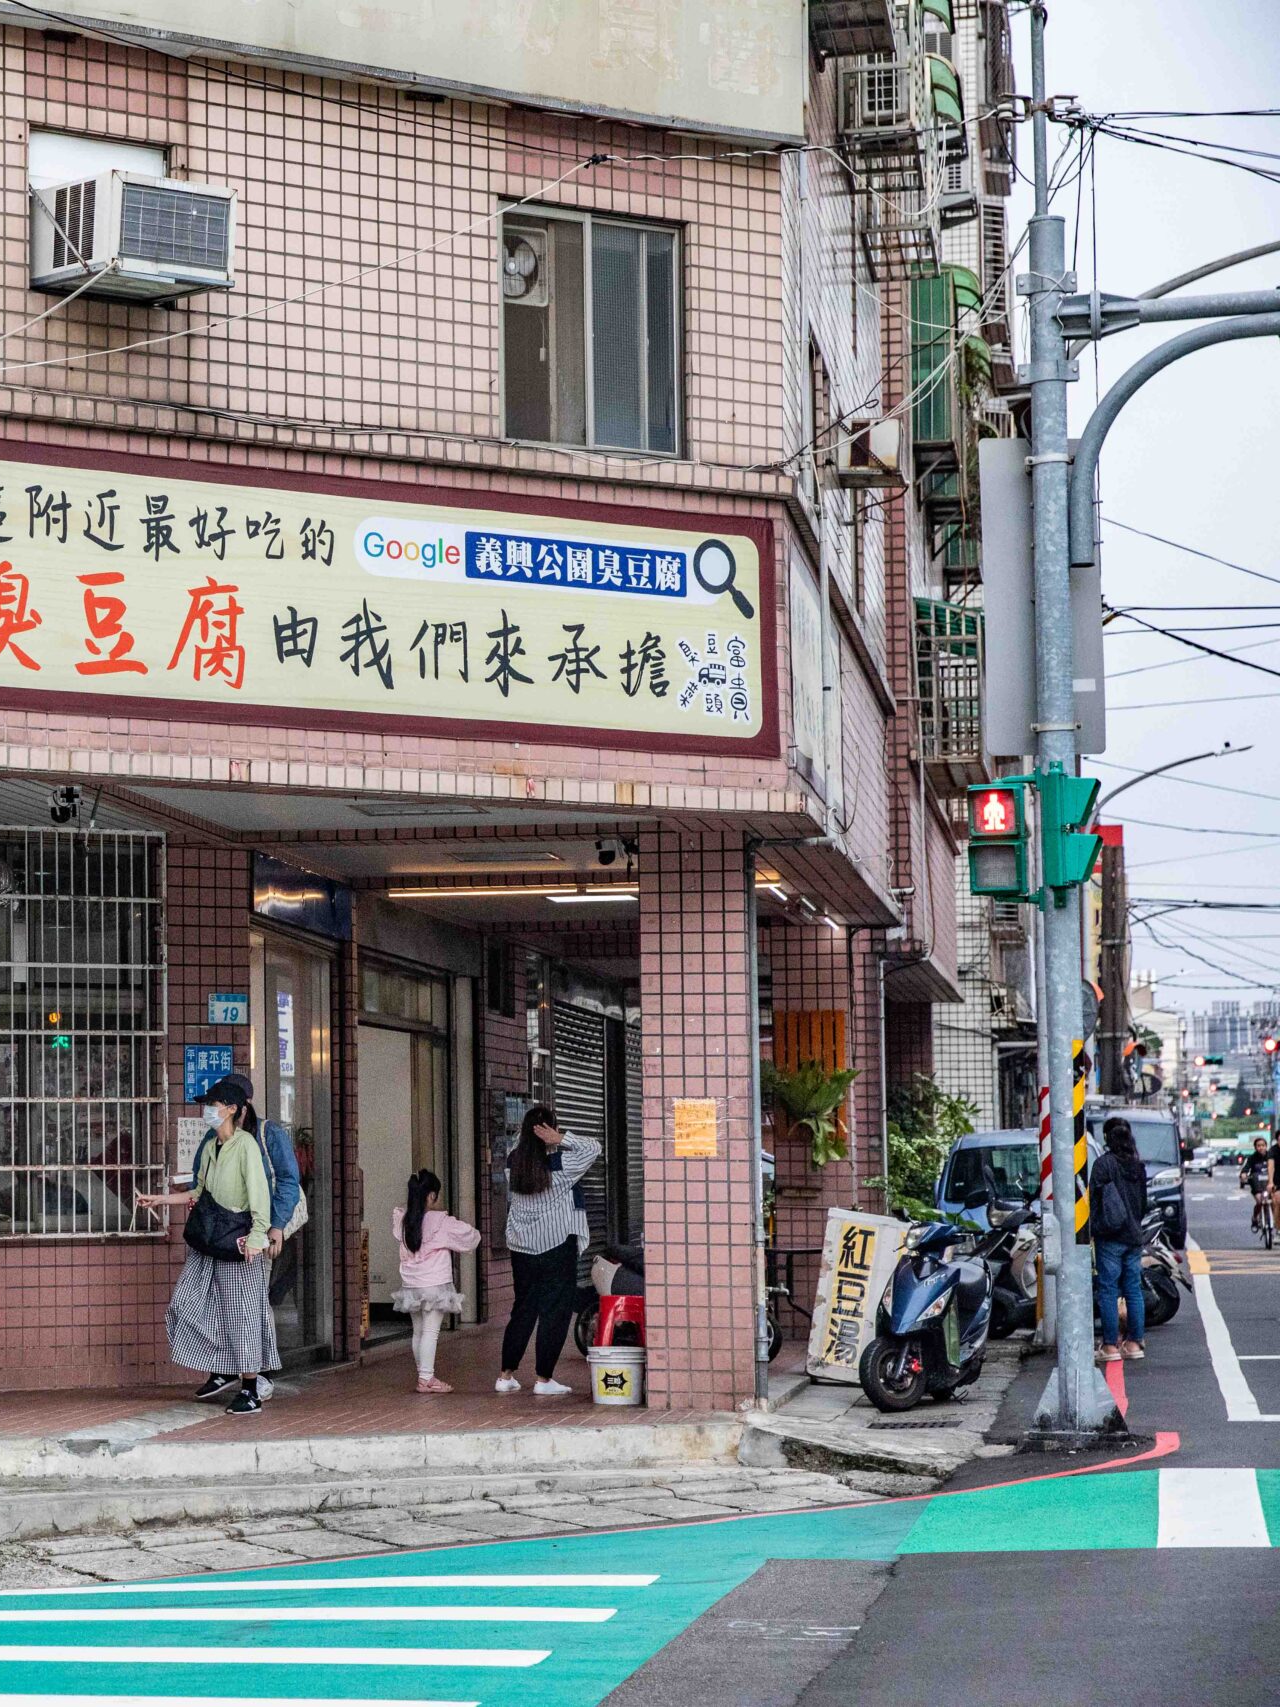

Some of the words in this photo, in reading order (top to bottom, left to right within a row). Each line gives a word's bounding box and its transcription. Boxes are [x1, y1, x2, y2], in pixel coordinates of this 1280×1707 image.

[363, 531, 461, 568] Google
[474, 536, 682, 593] 義興公園臭豆腐
[223, 1007, 239, 1022] 19
[197, 1050, 232, 1072] 廣平街
[824, 1225, 876, 1364] 紅豆湯
